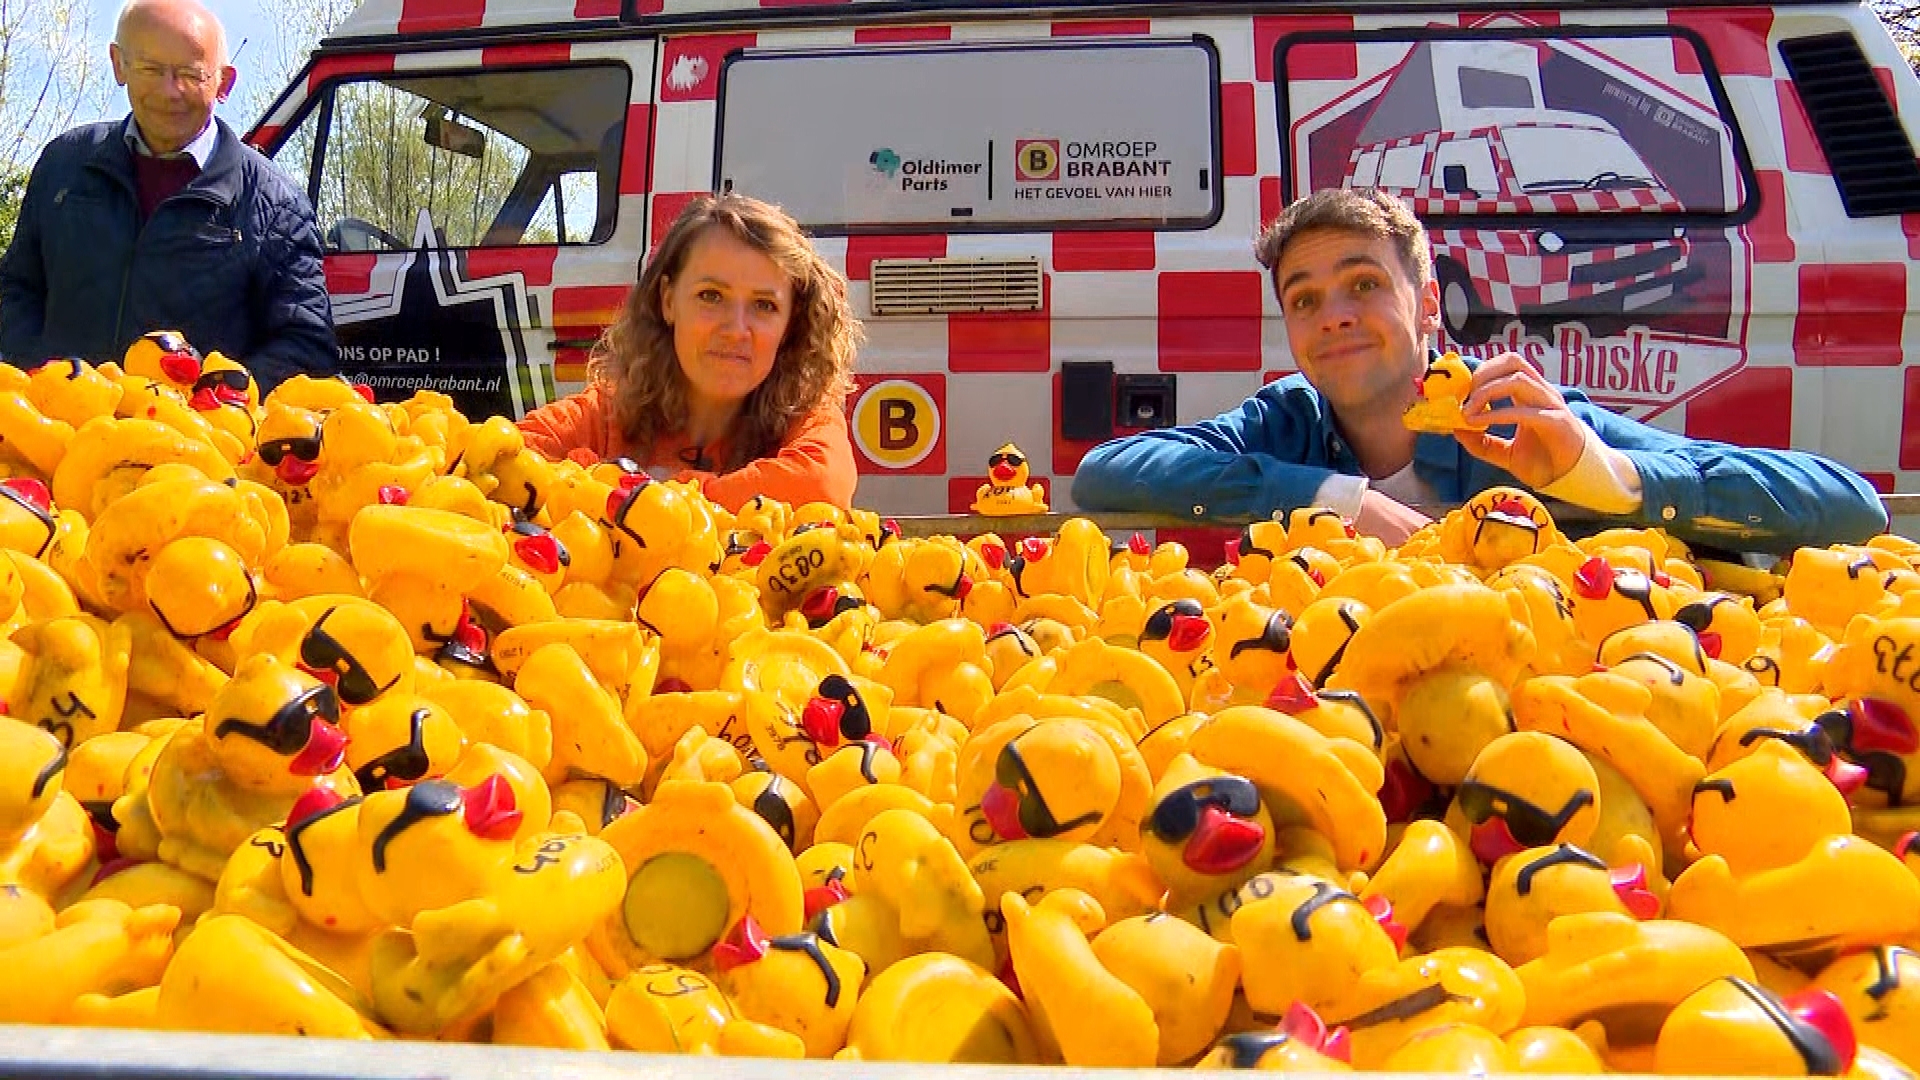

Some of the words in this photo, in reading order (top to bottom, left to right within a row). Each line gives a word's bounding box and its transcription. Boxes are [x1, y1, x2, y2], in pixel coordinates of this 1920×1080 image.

[1066, 141, 1157, 159] OMROEP
[902, 159, 982, 175] Oldtimer
[1030, 149, 1048, 171] B
[1067, 160, 1172, 177] BRABANT
[902, 177, 948, 191] Parts
[1014, 187, 1042, 199] HET
[1046, 187, 1102, 199] GEVOEL
[1105, 186, 1135, 198] VAN
[1139, 185, 1172, 198] HIER
[369, 347, 393, 362] OP
[397, 347, 430, 363] PAD
[1560, 327, 1679, 395] Buske
[879, 399, 919, 450] B
